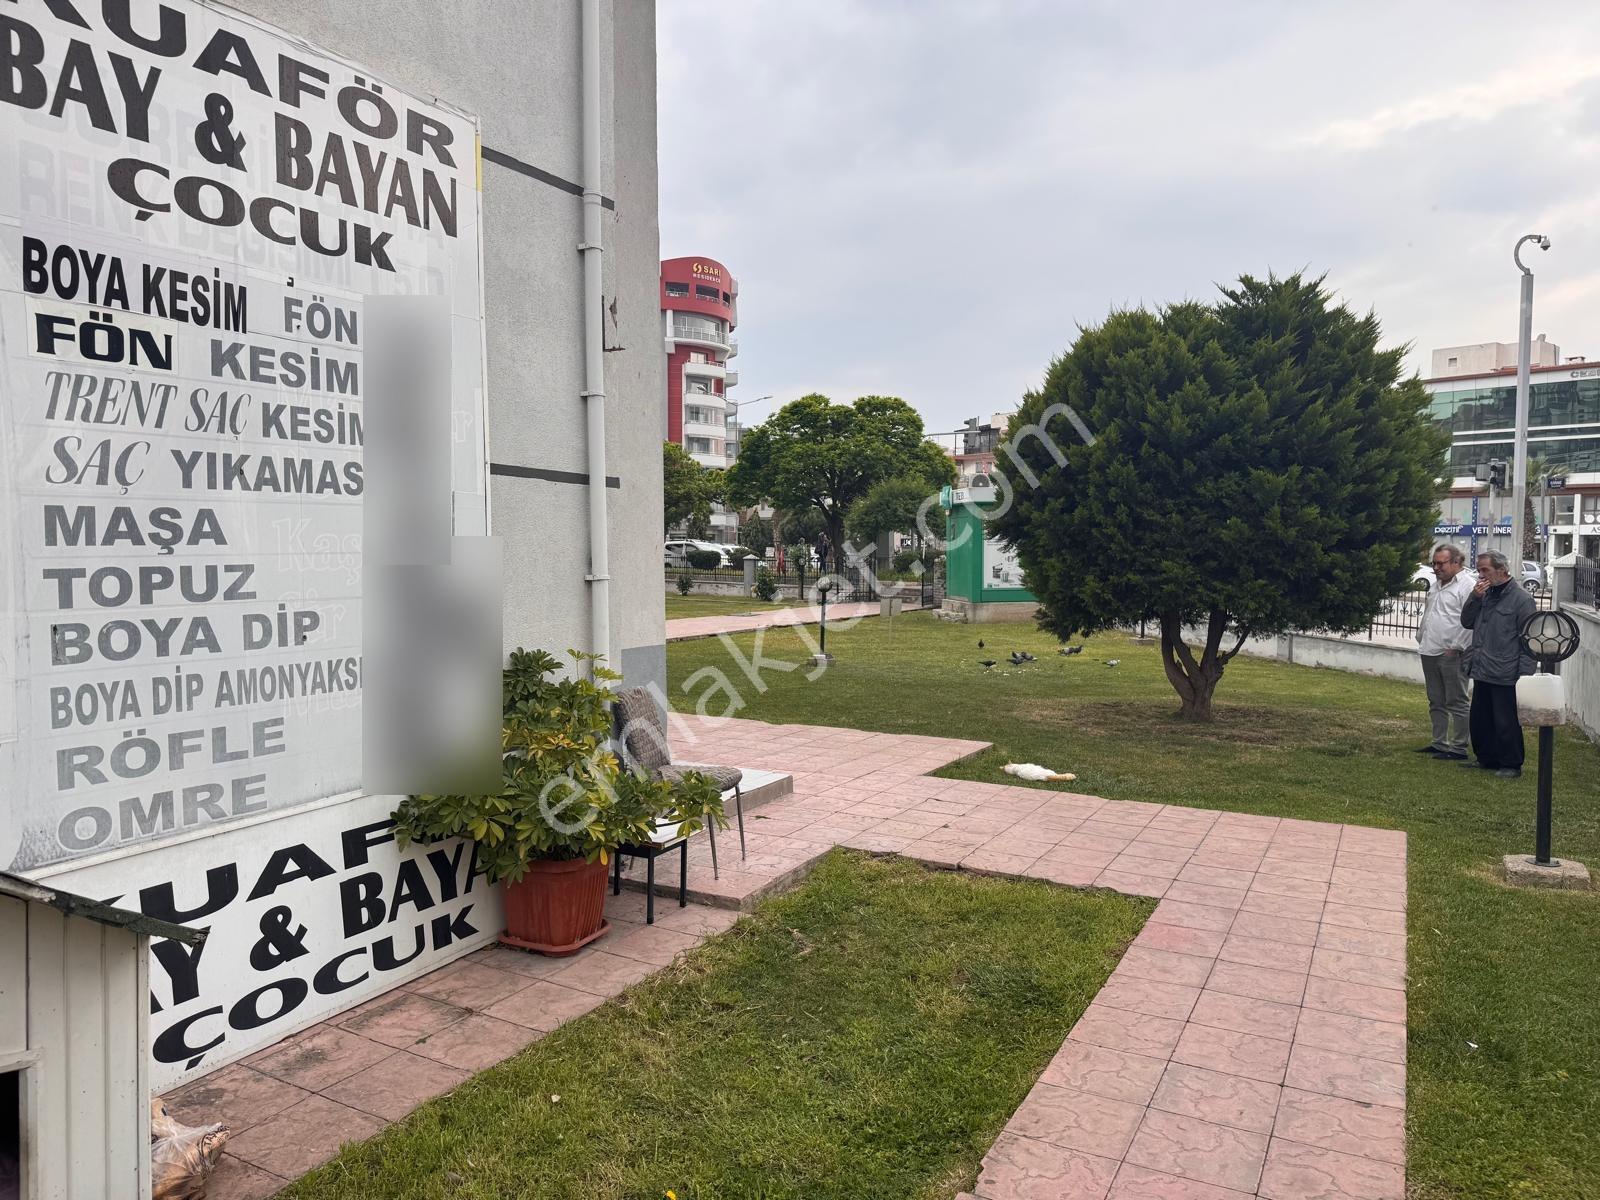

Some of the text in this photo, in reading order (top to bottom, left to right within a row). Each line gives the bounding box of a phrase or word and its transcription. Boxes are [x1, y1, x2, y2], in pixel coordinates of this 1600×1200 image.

[0, 14, 162, 143] BAY
[194, 92, 248, 173] &
[274, 111, 458, 238] BAYAN
[107, 157, 397, 273] ÇOCUK
[22, 236, 130, 311] BOYA
[142, 263, 248, 335] KESİM
[35, 310, 173, 371] FÖN
[284, 294, 358, 345] FÖN
[210, 338, 359, 396] KESİM
[45, 371, 178, 429] TRENT
[184, 387, 252, 441] SAÇ
[45, 435, 151, 495] SAÇ
[44, 504, 228, 555] MAŞA
[42, 563, 257, 610] TOPUZ
[51, 615, 222, 666] BOYA
[242, 603, 320, 652] DİP
[50, 679, 141, 729] BOYA
[152, 665, 204, 716] DİP
[56, 716, 286, 792] RÖFLE
[57, 773, 268, 851] OMRE
[248, 904, 311, 973] &
[153, 903, 480, 1072] ÇOCUK
